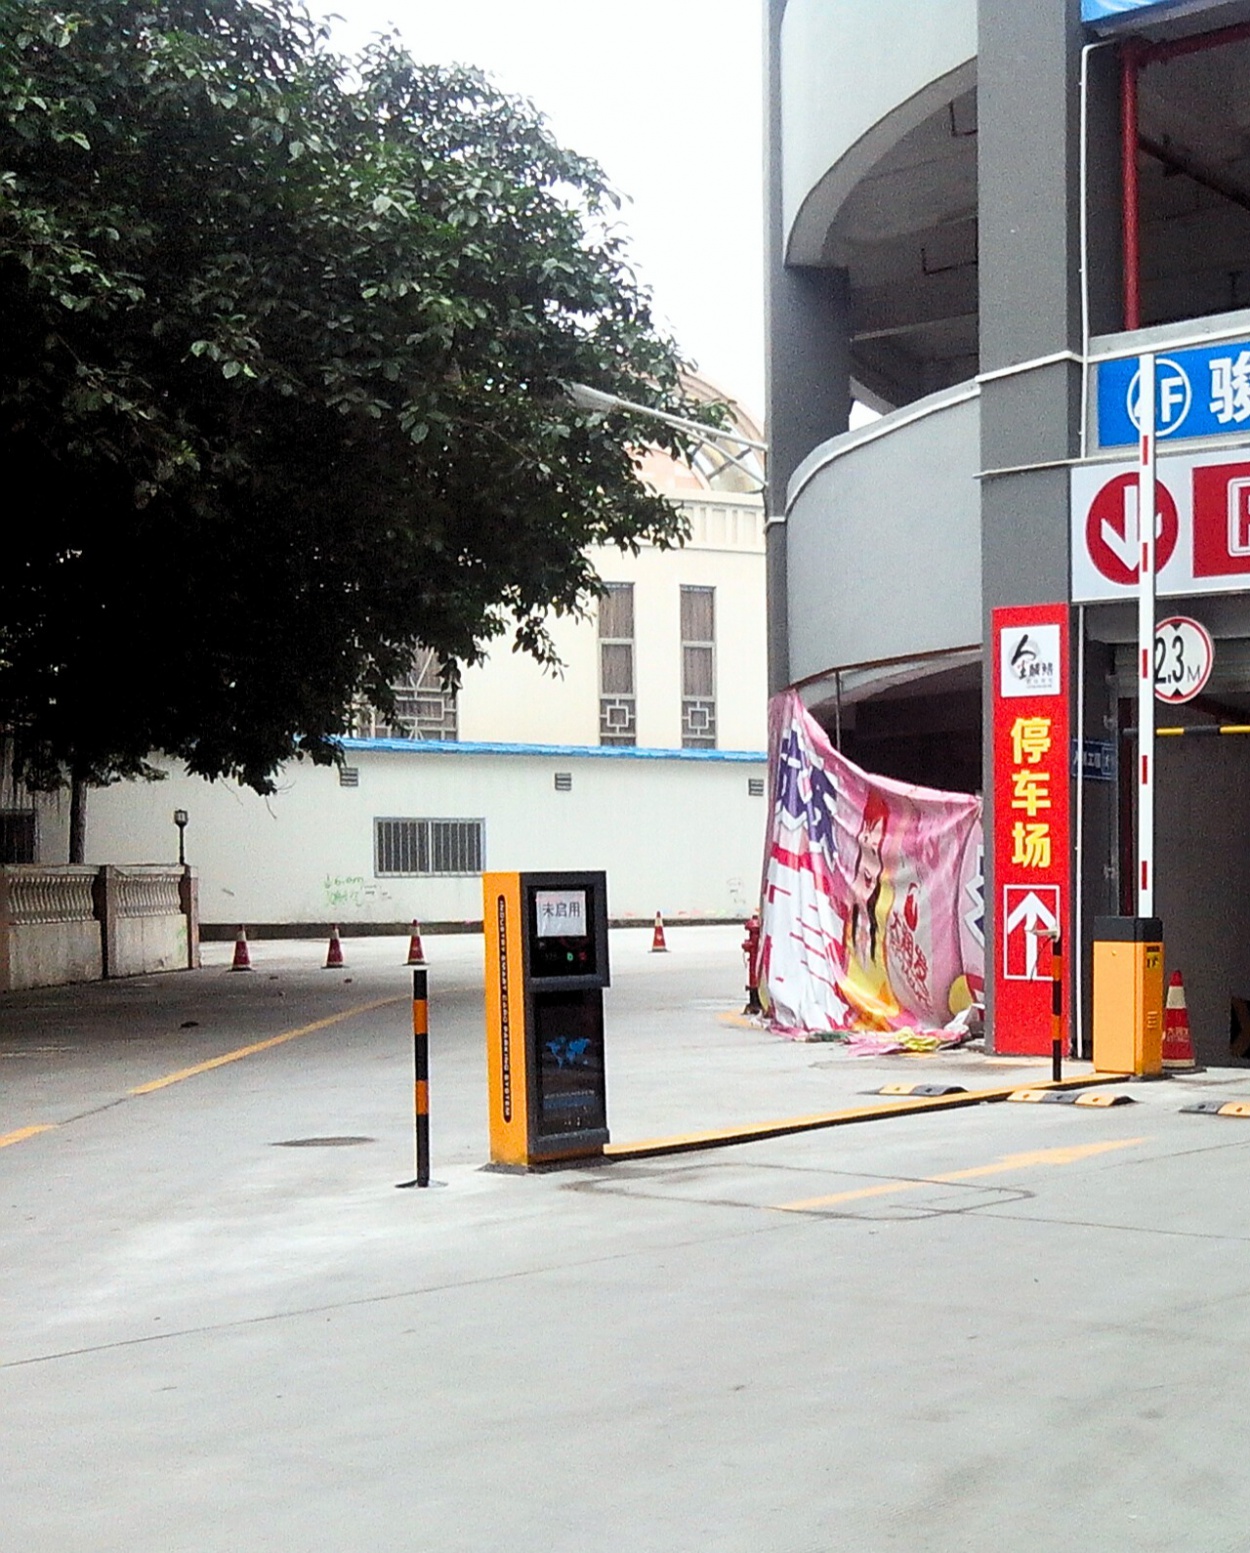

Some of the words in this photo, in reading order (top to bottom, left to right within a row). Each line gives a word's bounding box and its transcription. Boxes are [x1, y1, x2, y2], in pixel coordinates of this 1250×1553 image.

[1134, 376, 1183, 423] F
[1010, 717, 1051, 868] 停车场
[498, 900, 506, 952] INDUSTRY
[542, 901, 580, 918] 未启用
